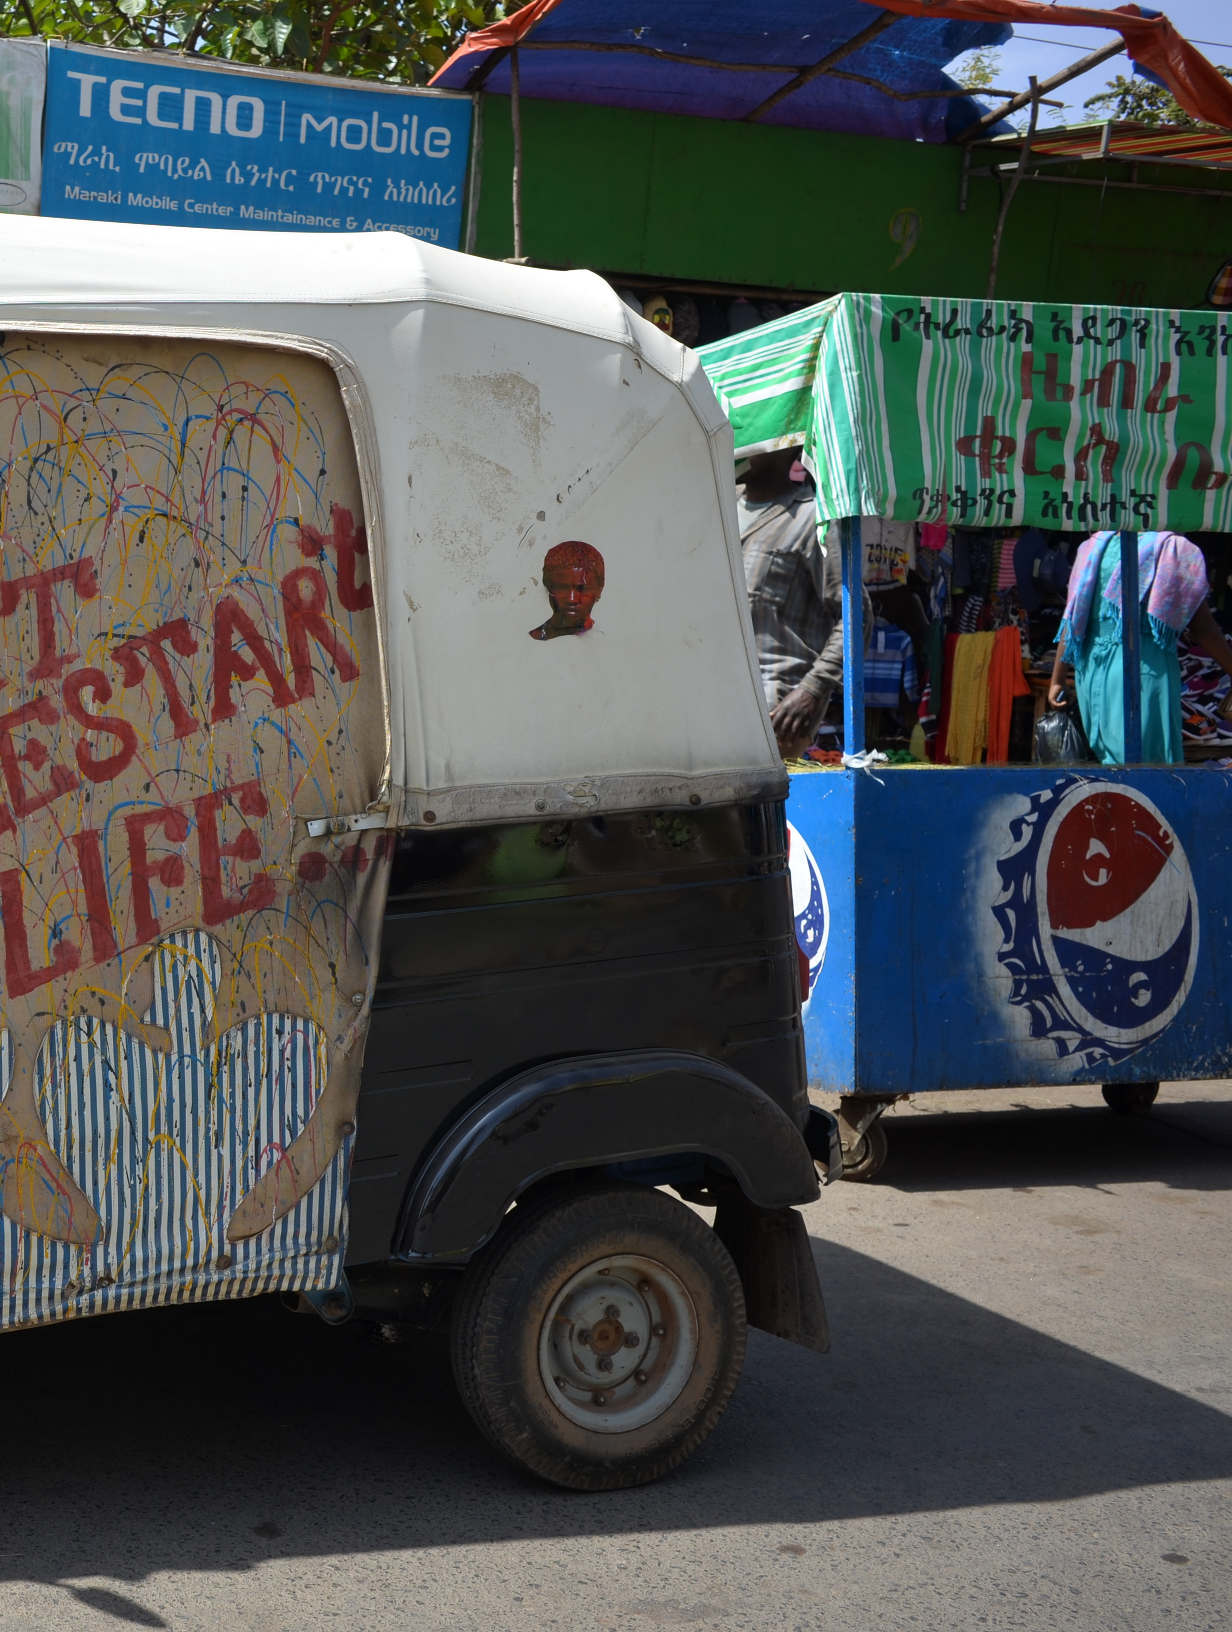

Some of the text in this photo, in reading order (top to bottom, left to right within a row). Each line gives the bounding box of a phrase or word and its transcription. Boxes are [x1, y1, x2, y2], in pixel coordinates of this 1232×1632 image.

[67, 70, 265, 139] TECNO
[53, 141, 120, 172] ማራኪ
[134, 151, 212, 181] ሞባይል
[225, 161, 296, 192] ሴንተር
[64, 185, 439, 240] Maraki Mobile Center Maintainance & Accessory
[1021, 351, 1194, 414] ዜብራ
[956, 415, 1232, 490] ቁርስ ቤ
